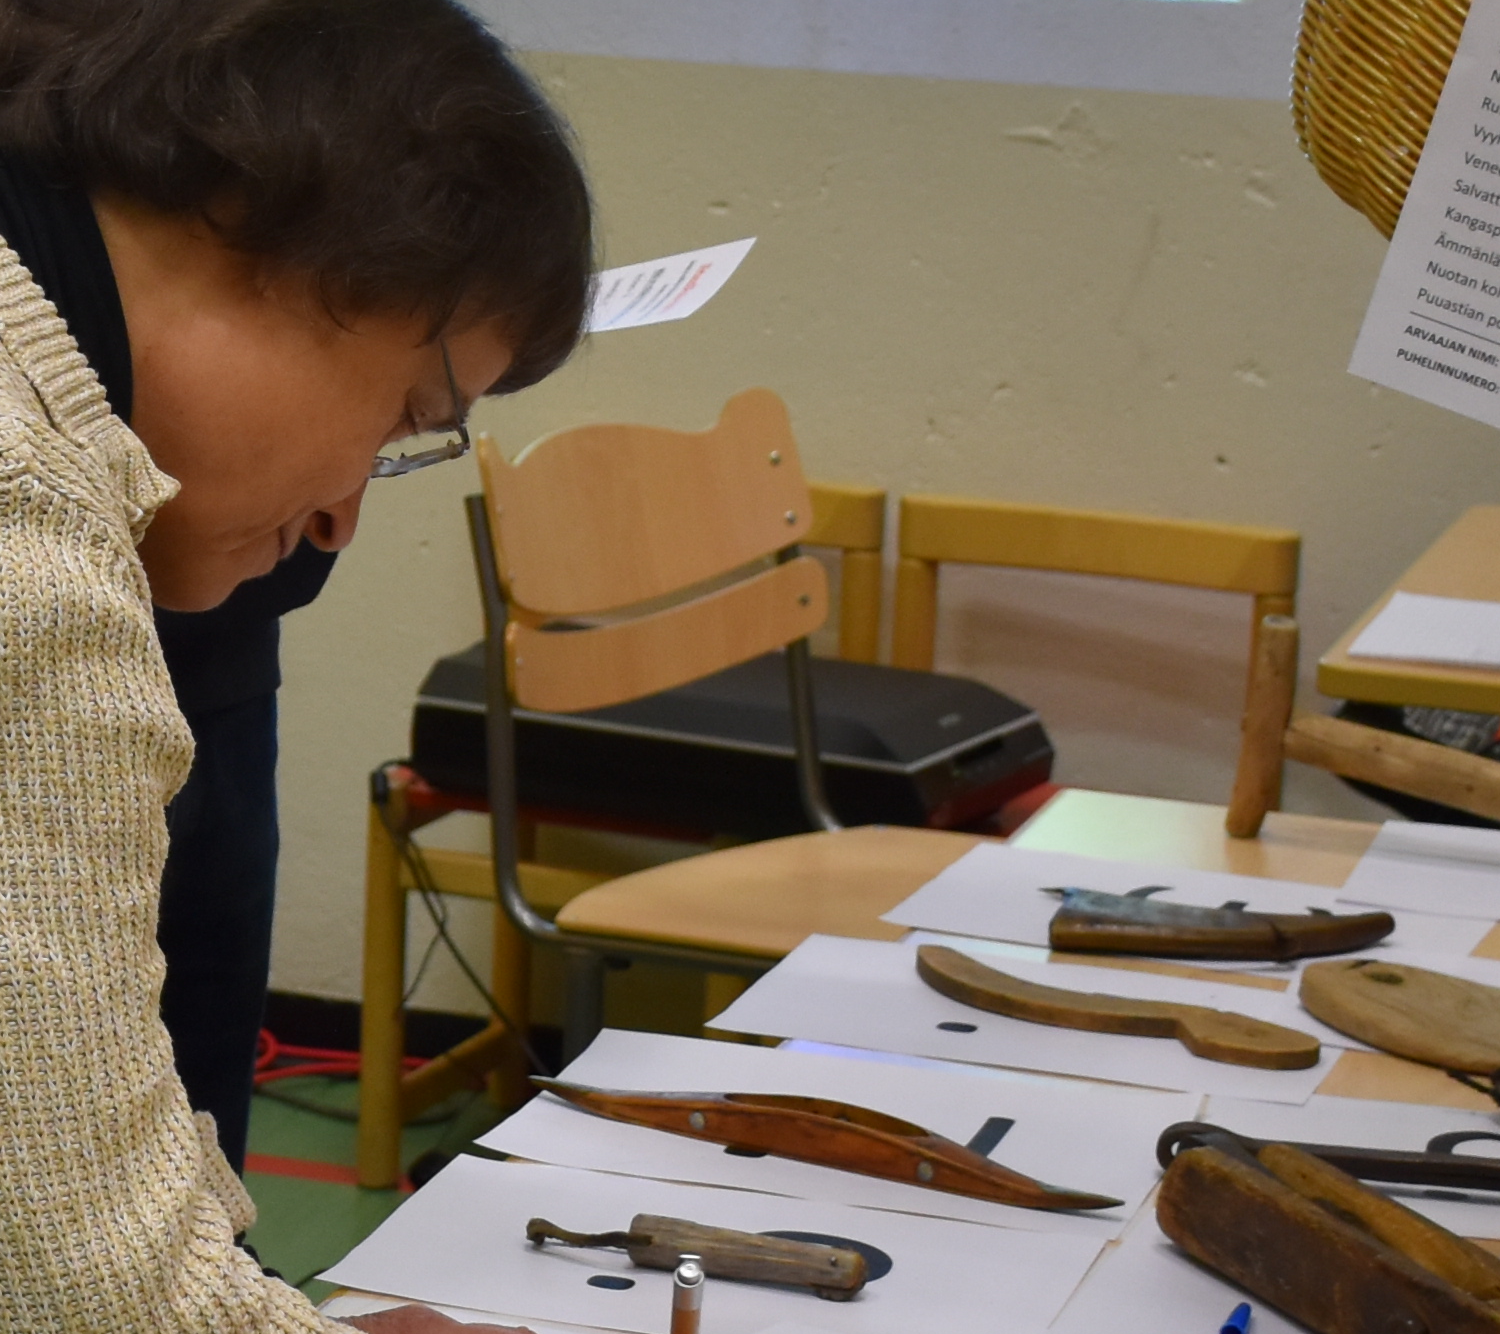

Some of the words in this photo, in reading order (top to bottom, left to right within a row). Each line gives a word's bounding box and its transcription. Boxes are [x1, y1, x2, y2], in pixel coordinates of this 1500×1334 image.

[1426, 260, 1478, 290] Nuotan
[1417, 287, 1485, 323] Puuastian
[1404, 324, 1467, 355] ARVAAJAN
[1468, 347, 1500, 367] NIMI:
[1396, 348, 1500, 394] PUHELINNUMERO:
